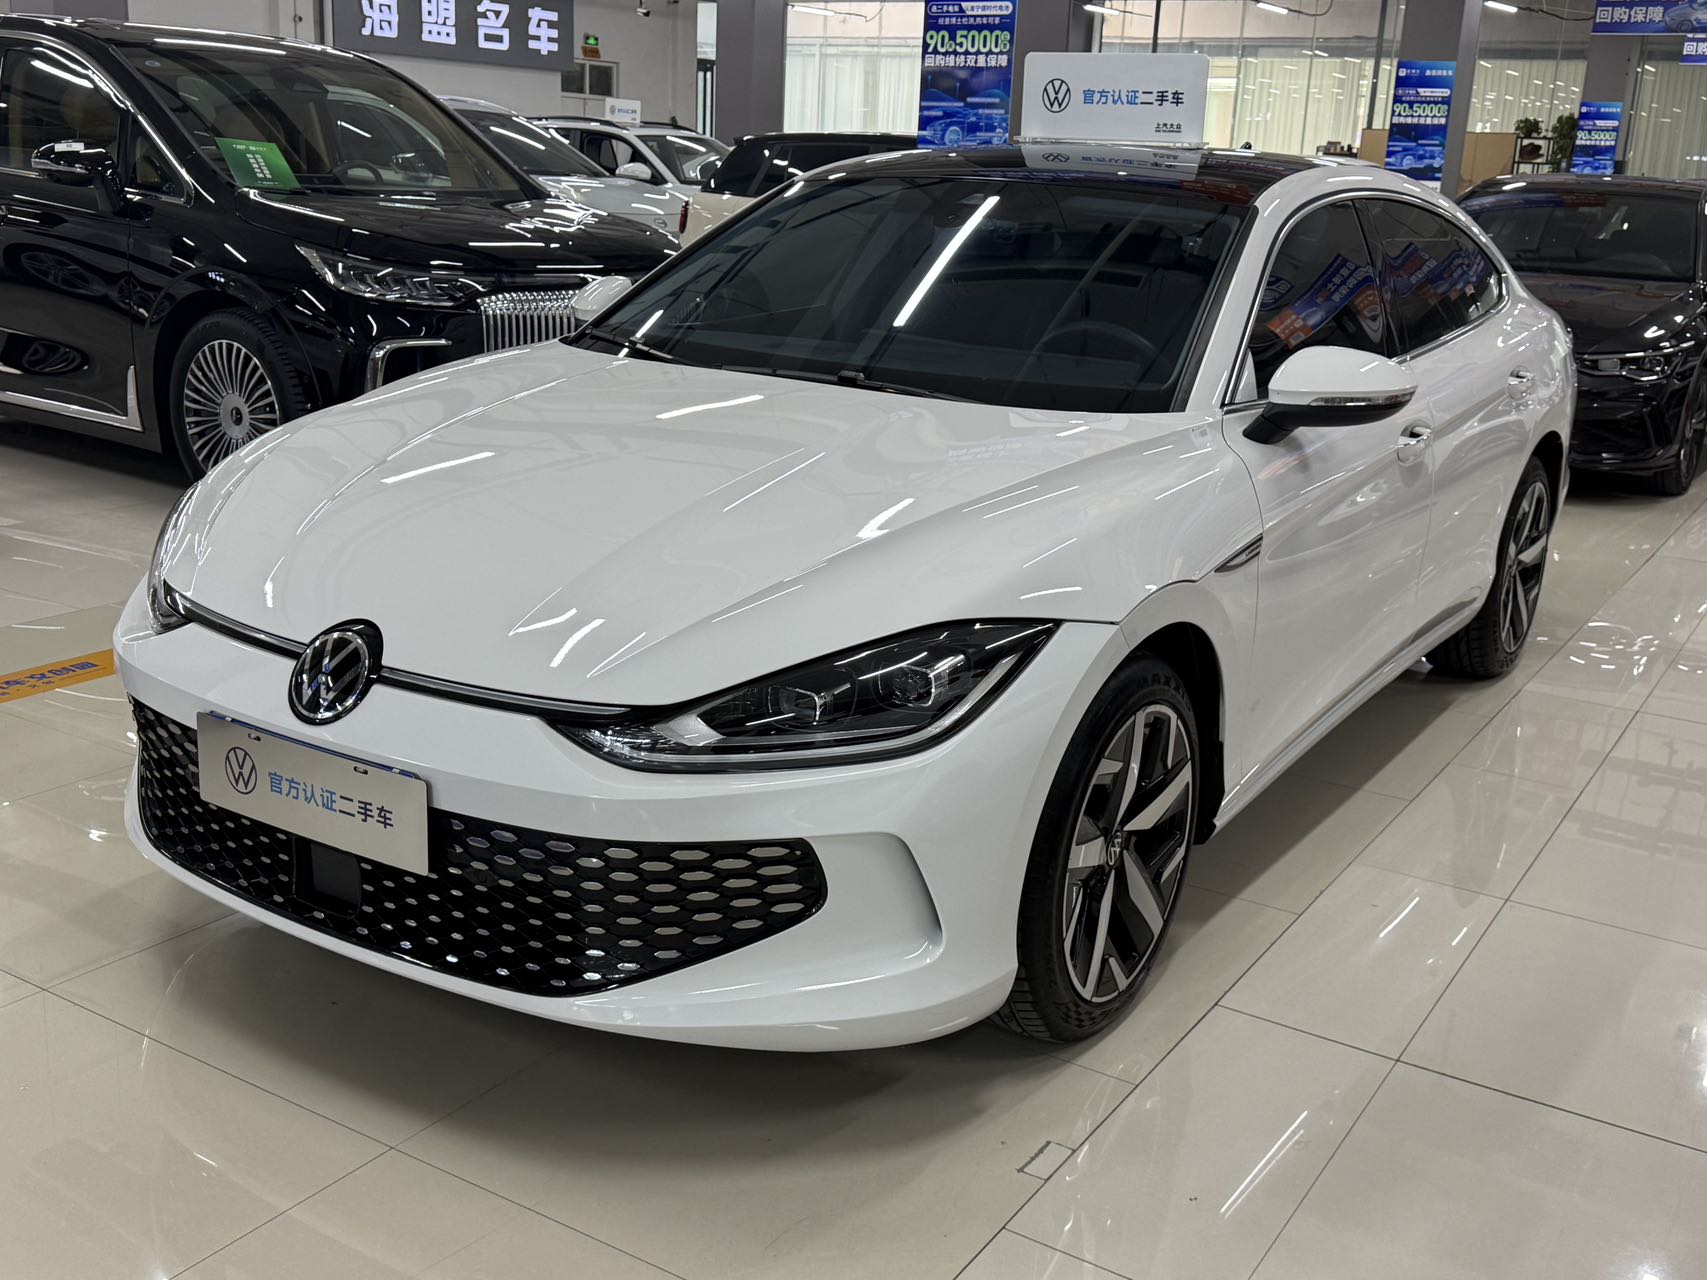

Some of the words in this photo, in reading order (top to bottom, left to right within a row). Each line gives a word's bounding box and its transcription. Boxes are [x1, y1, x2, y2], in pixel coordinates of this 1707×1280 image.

[1595, 6, 1664, 24] 回购保障
[924, 54, 1009, 68] 回购维修双重保障
[1082, 88, 1185, 107] 官方认证二手车
[1154, 122, 1182, 130] 上汽大众
[268, 771, 394, 829] 官方认证二手车
